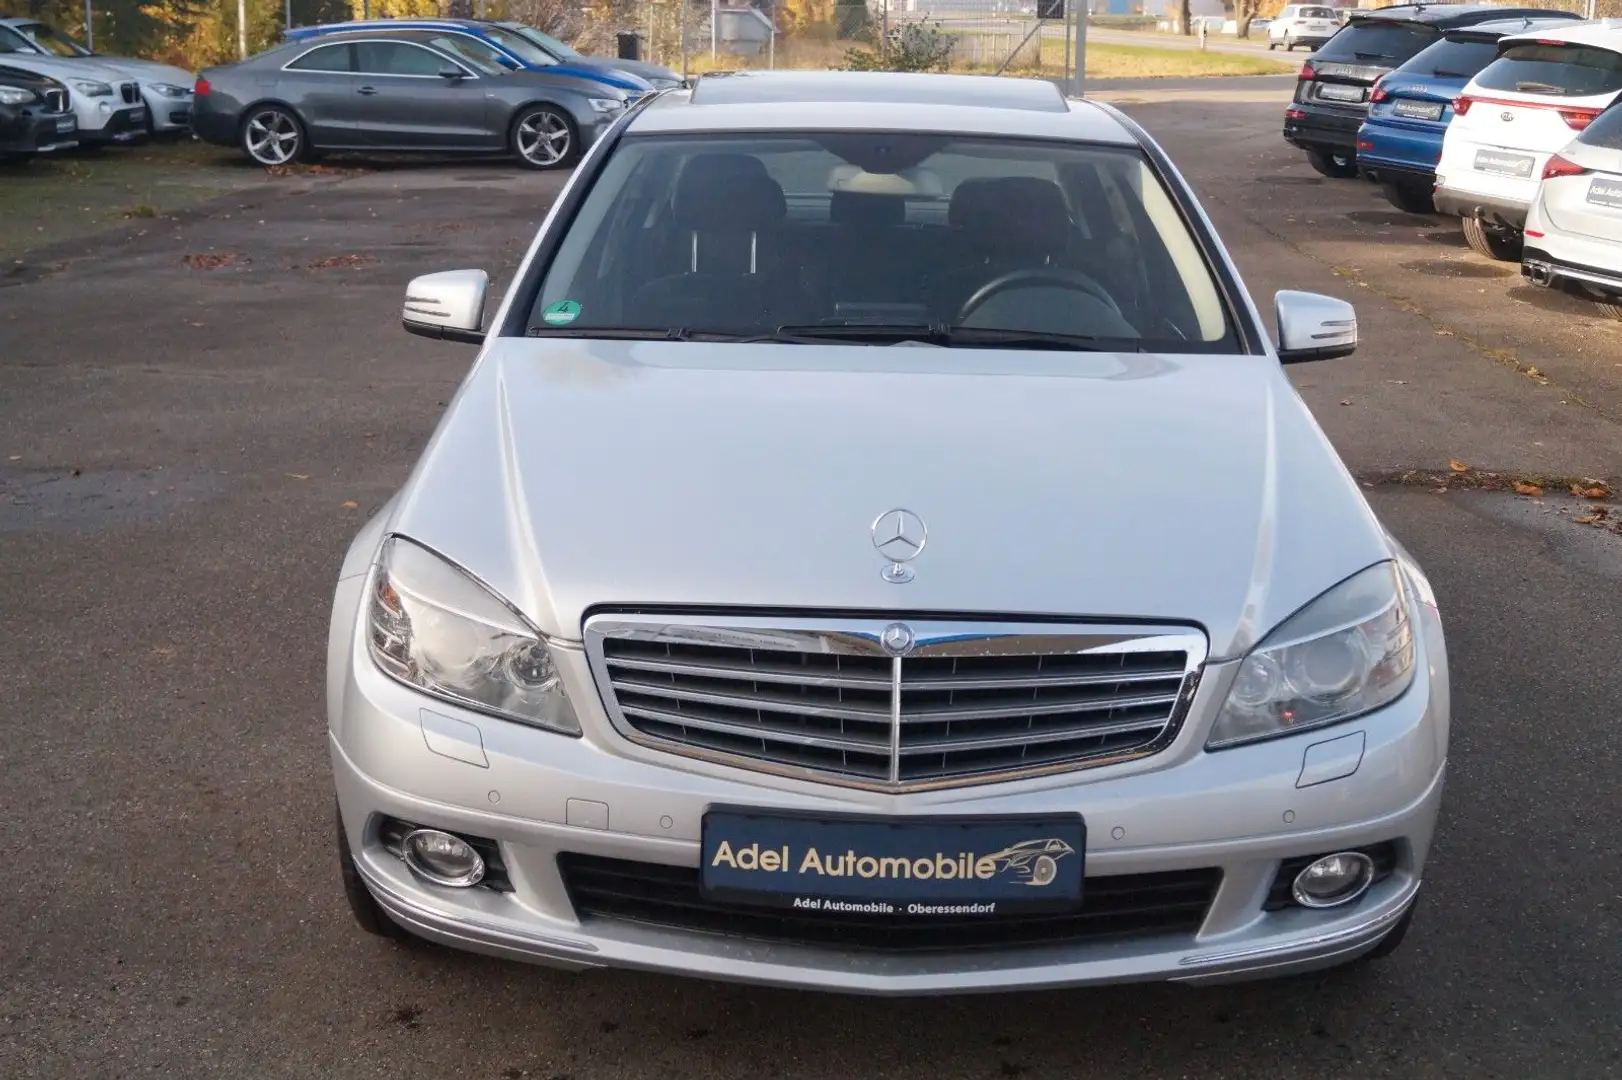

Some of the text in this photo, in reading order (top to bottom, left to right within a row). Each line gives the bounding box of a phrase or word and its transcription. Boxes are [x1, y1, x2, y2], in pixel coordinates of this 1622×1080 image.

[557, 301, 570, 313] 4
[711, 840, 997, 880] Adel Automobile
[793, 897, 996, 914] Adel Automobile Oberessendorf
